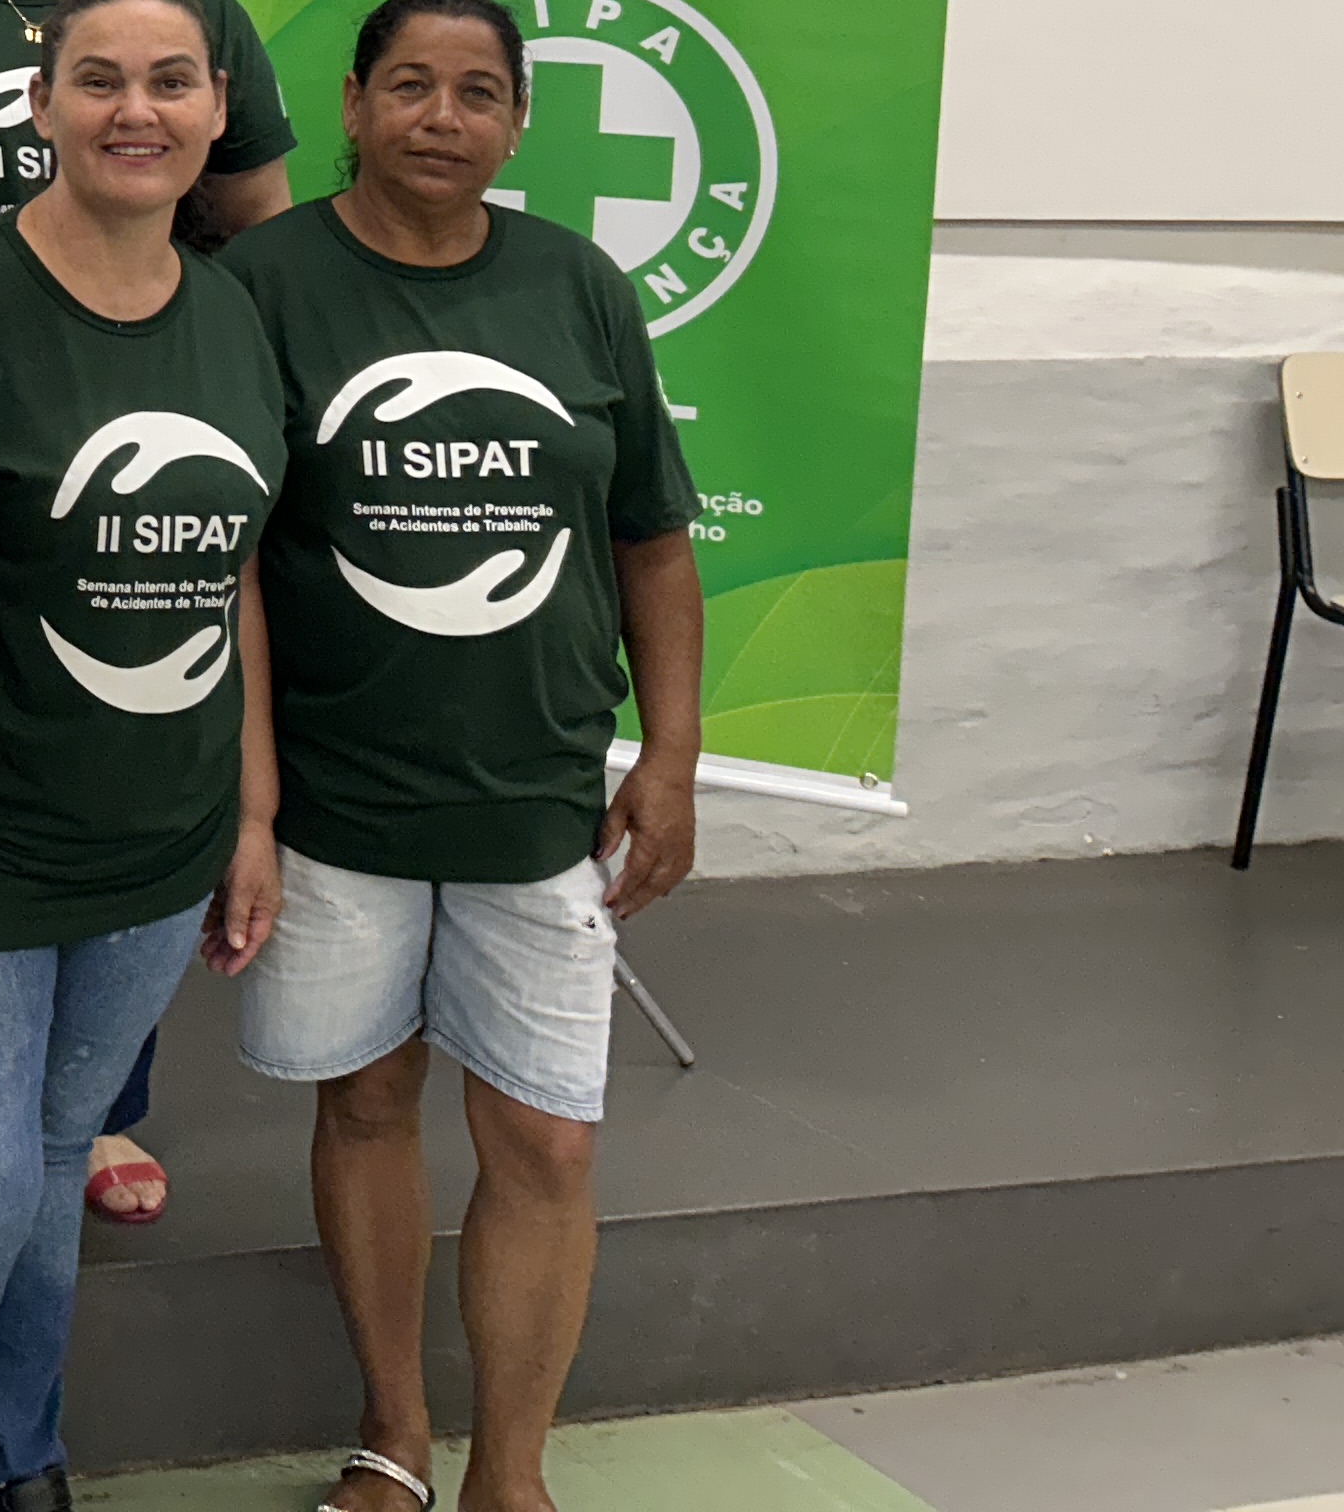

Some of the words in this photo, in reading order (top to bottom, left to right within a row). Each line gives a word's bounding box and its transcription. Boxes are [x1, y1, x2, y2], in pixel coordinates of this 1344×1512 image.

[362, 440, 388, 476] II
[403, 440, 539, 479] SIPAT
[353, 502, 408, 516] Semana
[412, 504, 461, 517] Interna
[464, 504, 482, 517] de
[485, 503, 554, 519] Prevenção
[369, 519, 387, 531] de
[388, 518, 459, 533] Acidentes
[462, 520, 480, 532] de
[483, 519, 541, 532] Trabalho
[96, 515, 121, 553] II
[133, 514, 248, 554] SIPAT
[77, 578, 131, 594] Semana
[134, 580, 176, 593] Interna
[179, 579, 194, 593] de
[91, 595, 109, 608] de
[111, 597, 172, 610] Acidentes
[175, 596, 190, 608] de
